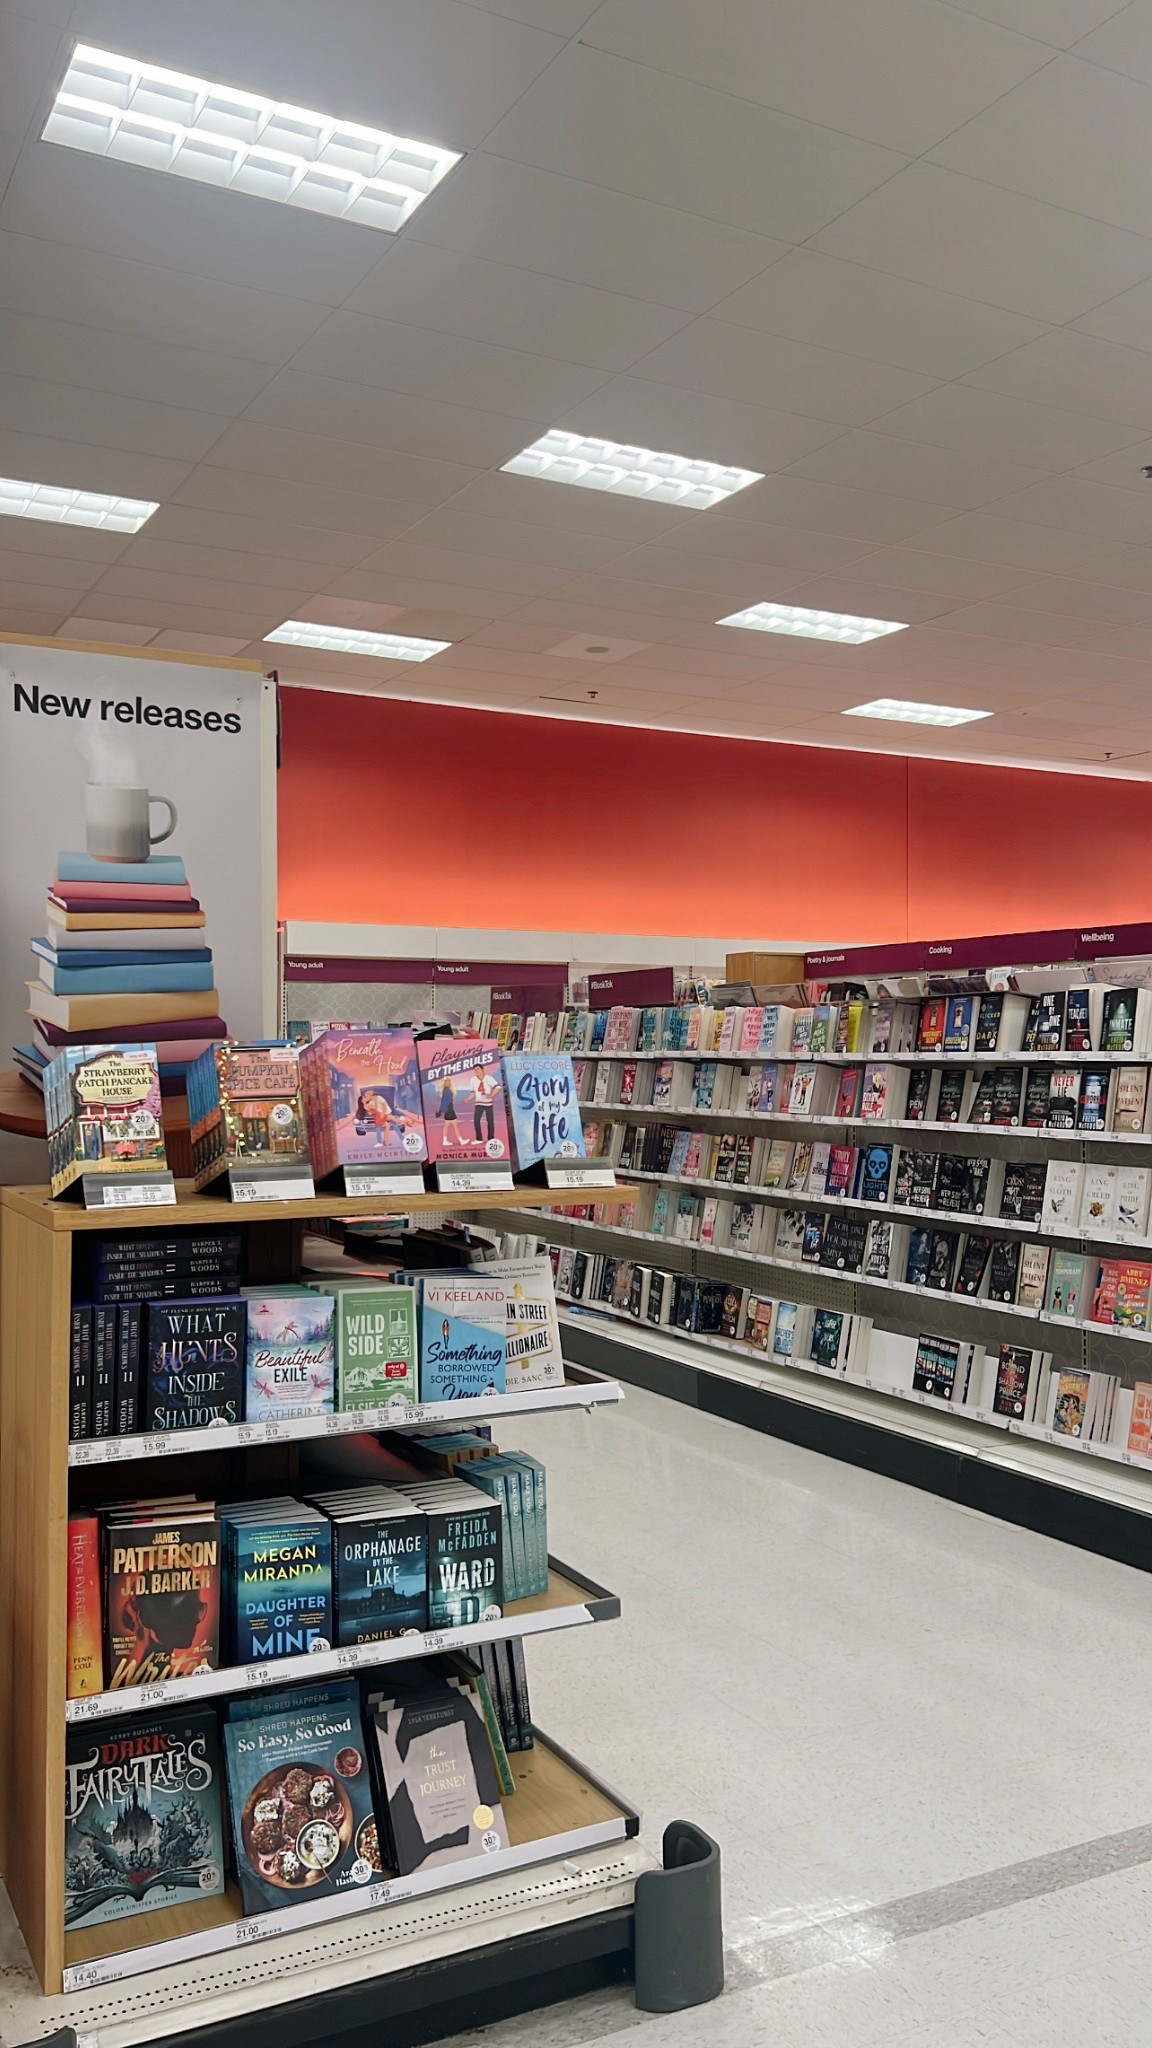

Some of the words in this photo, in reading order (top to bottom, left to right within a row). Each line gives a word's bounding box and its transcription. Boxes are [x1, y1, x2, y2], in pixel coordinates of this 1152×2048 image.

[14, 683, 92, 719] New
[100, 696, 242, 734] releases
[1081, 932, 1114, 942] Wellbeing
[928, 945, 952, 955] Cooking
[288, 961, 307, 969] Young
[807, 956, 821, 964] Poetry
[826, 954, 845, 963] journals
[437, 965, 454, 973] Young
[591, 980, 613, 989] #BookTok
[336, 1038, 382, 1062] Beneath
[430, 1044, 484, 1066] Playing
[249, 1053, 268, 1063] The
[373, 1054, 408, 1074] Hood
[84, 1067, 147, 1078] STRAWBERRY
[231, 1064, 288, 1077] PUMPKIN
[427, 1067, 441, 1080] BY
[443, 1060, 462, 1076] THE
[463, 1052, 494, 1070] RULES
[511, 1061, 536, 1071] LUCY
[539, 1060, 571, 1070] SCORE
[78, 1076, 109, 1088] PATCH
[111, 1076, 154, 1087] PANCAKE
[224, 1079, 261, 1091] SPICE
[264, 1074, 297, 1089] CAFÉ
[1054, 1075, 1075, 1087] NEVER
[102, 1087, 133, 1097] HOUSE
[517, 1073, 570, 1110] Story
[1120, 1085, 1144, 1093] SILENT
[347, 1152, 373, 1160] EMILY
[436, 1152, 468, 1160] MONICA
[471, 1151, 490, 1159] MUR
[452, 1180, 471, 1188] 14.39
[1053, 1174, 1071, 1183] KING
[1091, 1178, 1109, 1187] KING
[235, 1189, 257, 1197] 15.19
[863, 1182, 887, 1190] LIGHTS
[1086, 1191, 1111, 1200] GREED
[1024, 1261, 1045, 1270] SILENT
[191, 1286, 223, 1294] WOODS
[428, 1291, 440, 1302] VI
[444, 1291, 505, 1302] KEELAND
[506, 1302, 516, 1319] IN
[519, 1304, 547, 1320] STREET
[168, 1313, 226, 1334] WHAT
[346, 1314, 386, 1336] WILD
[348, 1335, 384, 1357] SIDE
[506, 1330, 548, 1359] ILLIONAIRE
[152, 1331, 238, 1374] HUNTS
[255, 1345, 326, 1370] Beautiful
[426, 1342, 502, 1367] Something
[274, 1367, 308, 1383] EXILE
[430, 1375, 487, 1383] SOMETHING
[505, 1378, 519, 1386] DIE
[521, 1374, 543, 1384] SANC
[168, 1371, 225, 1395] INSIDE
[184, 1395, 206, 1407] THE
[73, 1403, 81, 1438] WOODS
[95, 1401, 104, 1436] WOODS
[119, 1399, 128, 1433] WOODS
[152, 1400, 237, 1431] SHADOWS
[404, 1410, 424, 1419] 15.99
[144, 1441, 166, 1450] 15.99
[377, 1530, 389, 1539] THE
[447, 1518, 488, 1537] FREIDA
[153, 1531, 181, 1545] JAMES
[438, 1531, 497, 1553] McFADDEN
[72, 1534, 87, 1565] HEAT
[253, 1545, 317, 1564] MEGAN
[344, 1535, 422, 1561] ORPHANAGE
[113, 1540, 217, 1574] PATTERSON
[373, 1559, 381, 1567] BY
[382, 1556, 394, 1566] THE
[244, 1563, 325, 1583] MIRANDA
[366, 1565, 400, 1588] LAKE
[438, 1557, 495, 1593] WARD
[152, 1569, 211, 1594] BARKER
[245, 1595, 326, 1615] DAUGHTER
[273, 1615, 294, 1628] OF
[252, 1627, 321, 1657] MINE
[357, 1630, 395, 1644] DANIEL
[424, 1638, 443, 1647] 14.39
[73, 1656, 93, 1664] PENN
[155, 1652, 171, 1663] The
[338, 1654, 358, 1664] 14.39
[74, 1663, 93, 1671] COLE
[246, 1671, 268, 1681] 15.19
[141, 1690, 164, 1701] 21.00
[263, 1701, 290, 1712] SHRED
[292, 1693, 330, 1706] HAPPENS
[74, 1703, 99, 1715] 21.69
[259, 1723, 288, 1733] SHRED
[289, 1713, 328, 1727] HAPPENS
[109, 1731, 131, 1740] KERRY
[133, 1726, 162, 1736] ROSANES
[237, 1737, 256, 1753] So
[258, 1733, 293, 1749] Easy,
[295, 1727, 313, 1741] So
[315, 1718, 352, 1737] Good
[100, 1732, 171, 1765] DARK
[429, 1744, 446, 1760] the
[424, 1759, 457, 1777] TRUST
[420, 1774, 467, 1797] JOURNEY
[370, 1889, 391, 1901] 17.49
[104, 1906, 124, 1916] COLOR
[126, 1900, 152, 1911] SINISTER
[154, 1893, 178, 1905] STORIES
[236, 1925, 259, 1938] 21.00
[73, 1969, 98, 1983] 14.40
